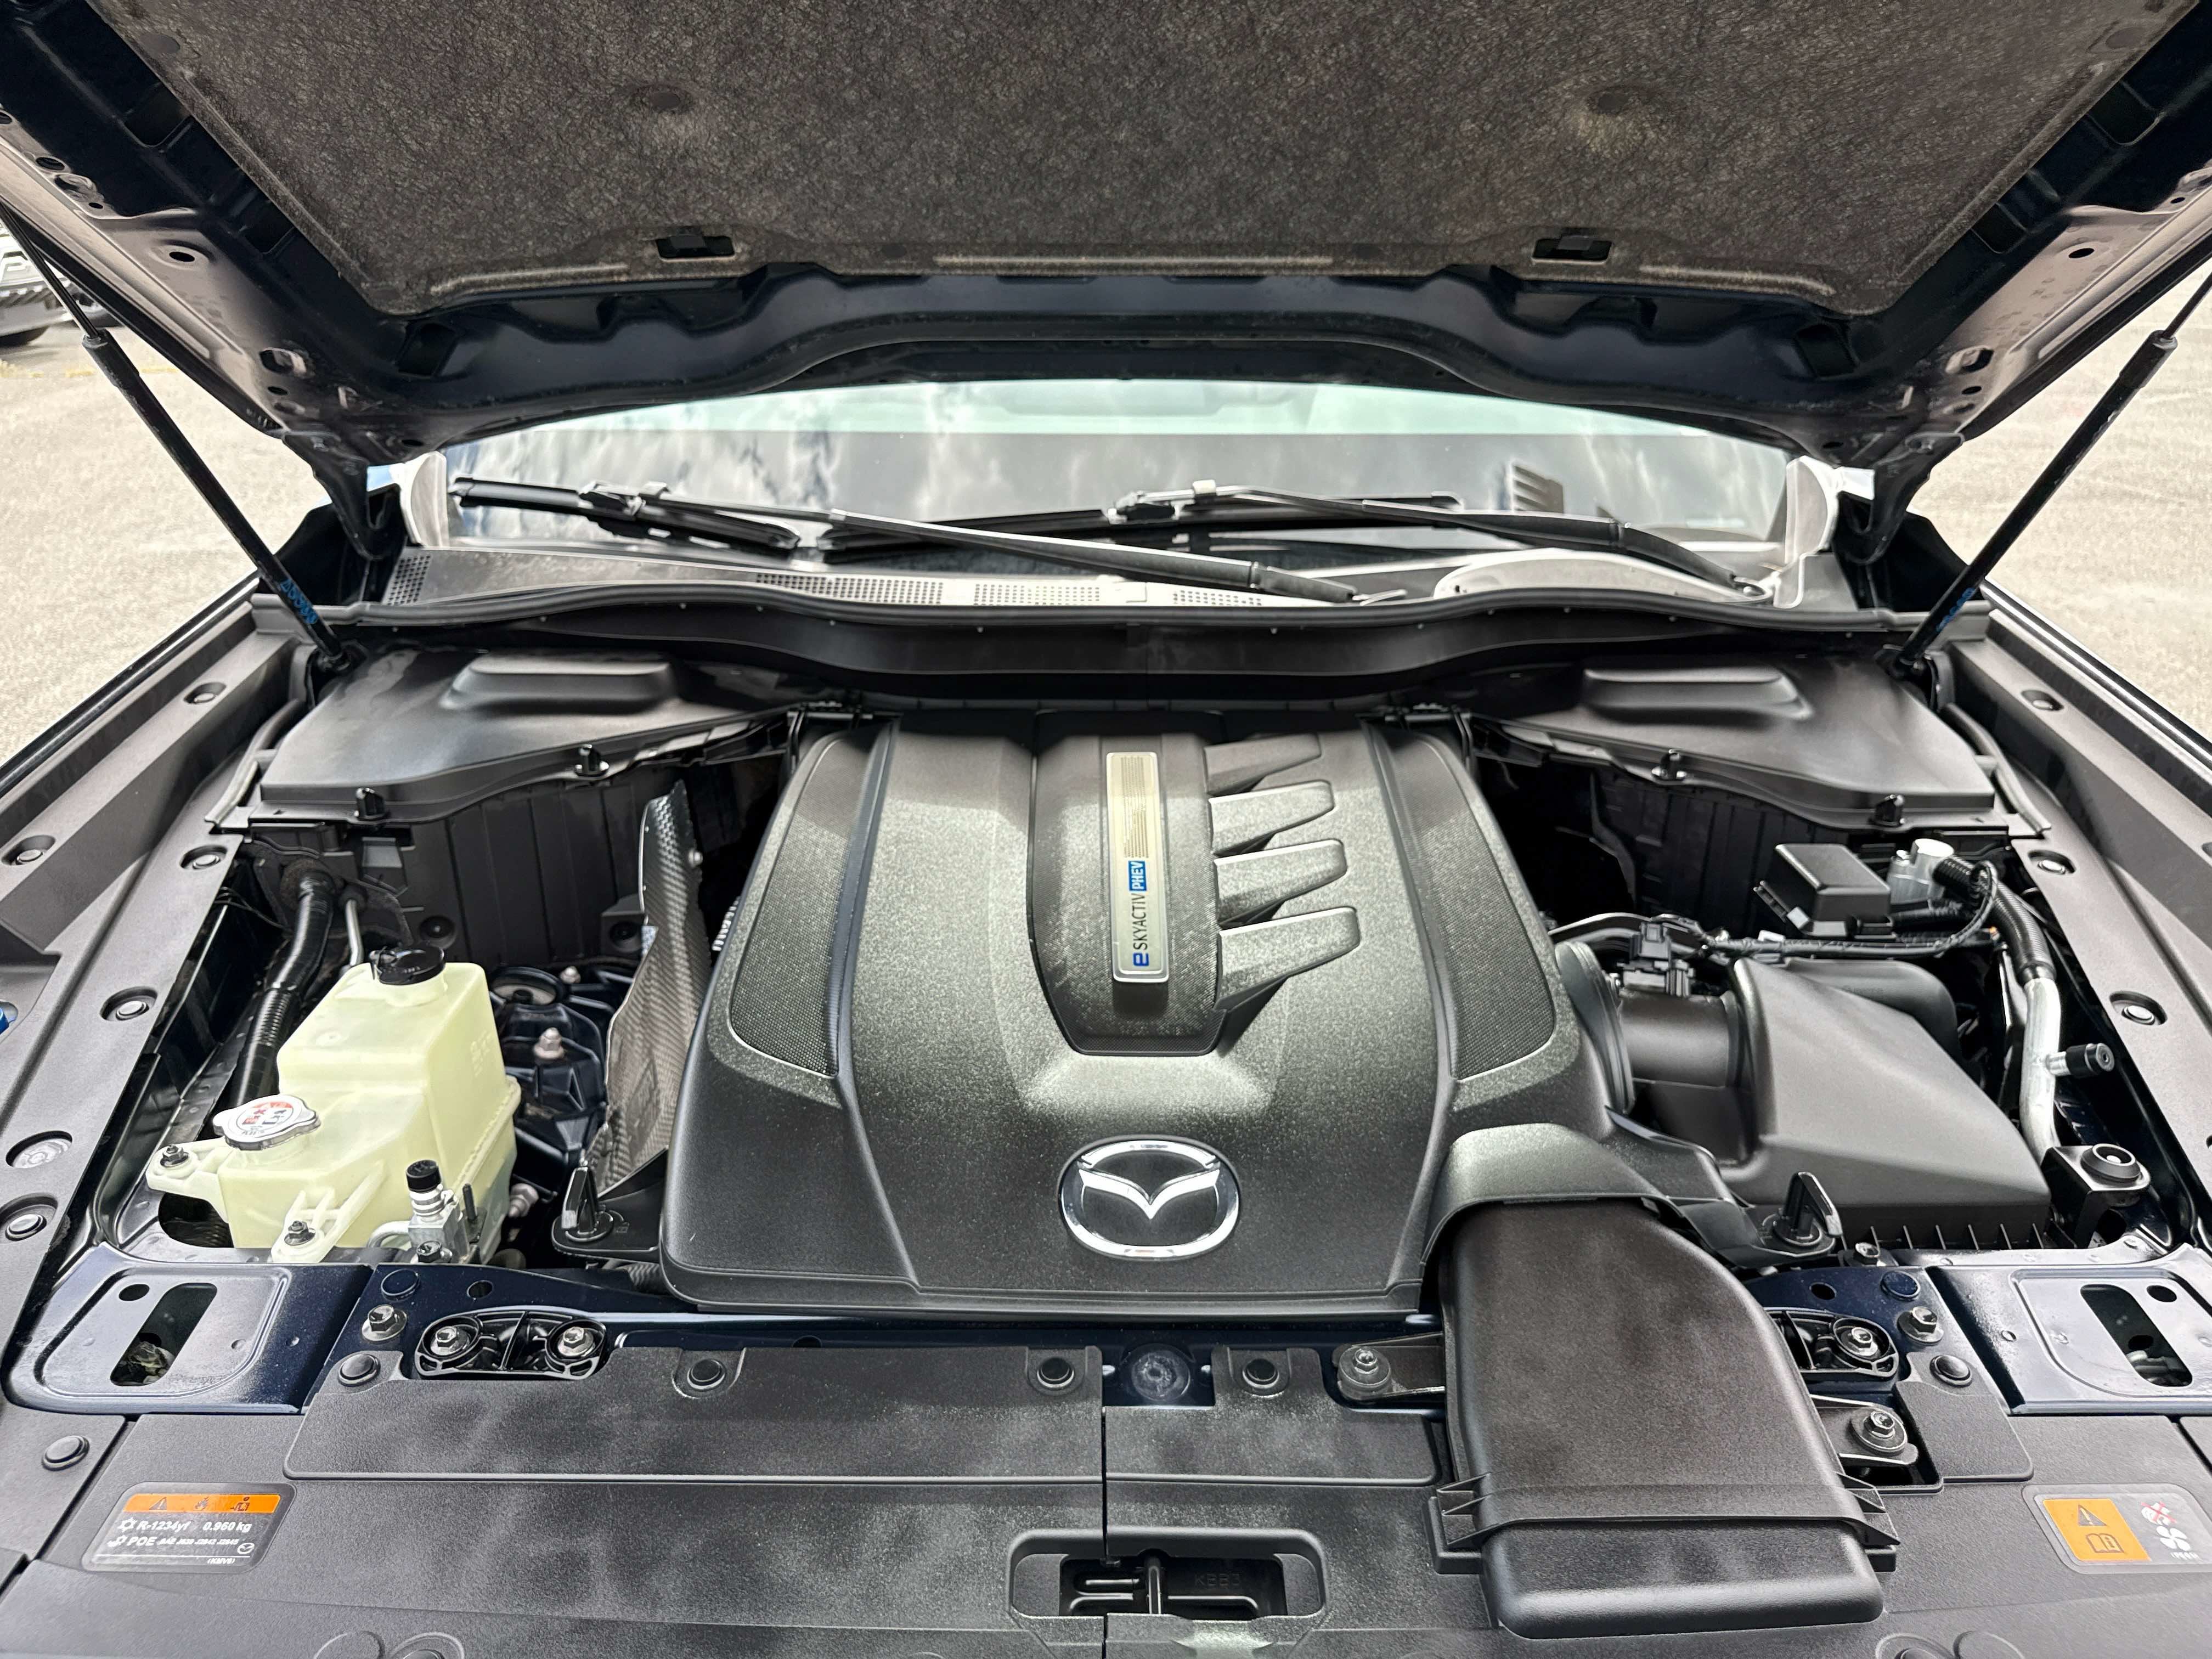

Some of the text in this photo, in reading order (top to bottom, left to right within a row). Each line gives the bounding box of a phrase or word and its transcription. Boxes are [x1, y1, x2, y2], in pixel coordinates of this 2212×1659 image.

[1131, 861, 1145, 890] PHEV
[1131, 893, 1148, 950] SKYACTIV
[137, 1521, 252, 1533] R-1234yf 0.960 kg
[127, 1537, 157, 1546] POE
